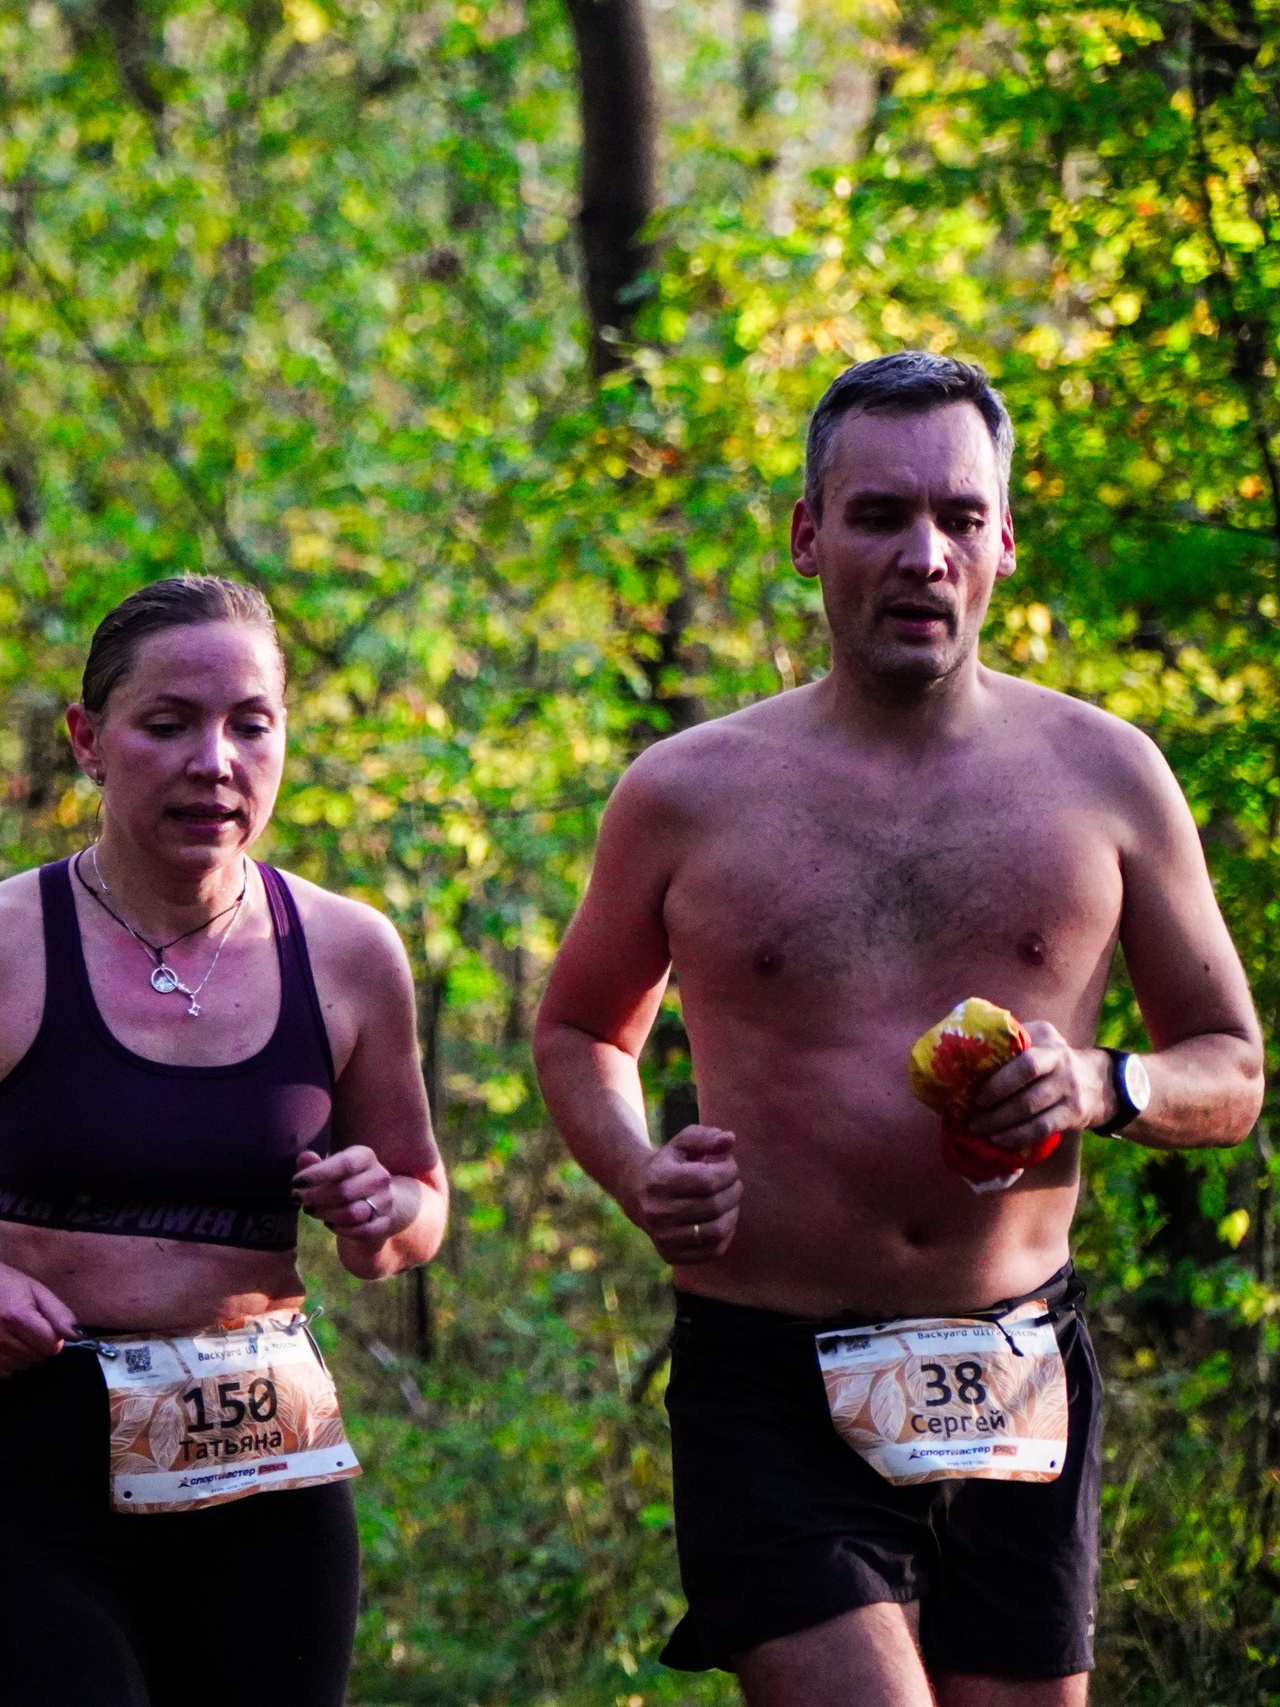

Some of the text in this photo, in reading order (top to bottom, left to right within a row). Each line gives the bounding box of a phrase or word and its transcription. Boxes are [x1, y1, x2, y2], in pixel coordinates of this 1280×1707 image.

[197, 1347, 242, 1363] Backyard
[920, 1361, 987, 1407] 38
[182, 1377, 278, 1433] 150
[910, 1409, 1006, 1438] Сергей
[178, 1431, 283, 1462] Татьяна
